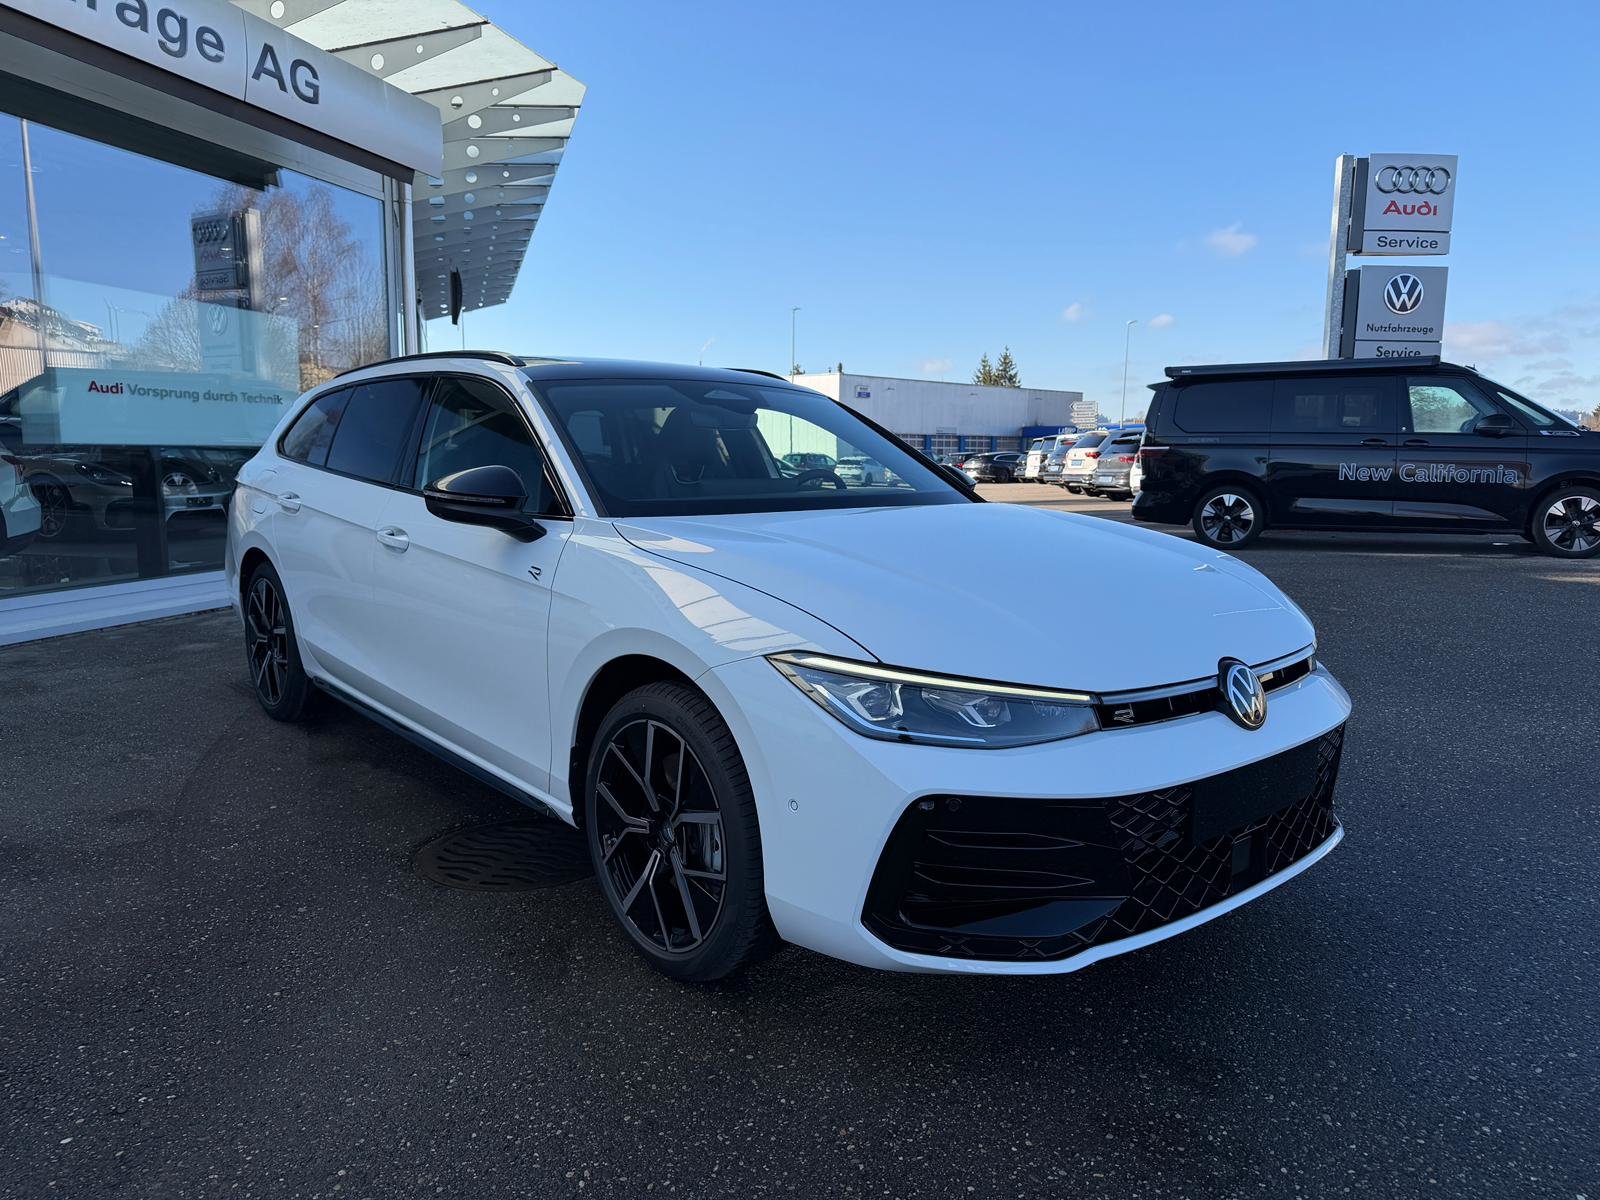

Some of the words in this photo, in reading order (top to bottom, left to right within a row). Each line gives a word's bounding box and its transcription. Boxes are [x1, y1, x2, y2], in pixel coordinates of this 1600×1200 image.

[251, 43, 320, 105] AG
[1383, 200, 1438, 216] Audi
[1377, 236, 1438, 249] Service
[1366, 323, 1434, 334] Nutzfahrzeuge
[1376, 346, 1421, 357] Service
[88, 380, 123, 394] Audi
[127, 384, 199, 402] Vorsprung
[203, 390, 237, 402] durch
[240, 392, 283, 405] Technik
[1339, 463, 1392, 481] New
[1400, 464, 1518, 484] California
